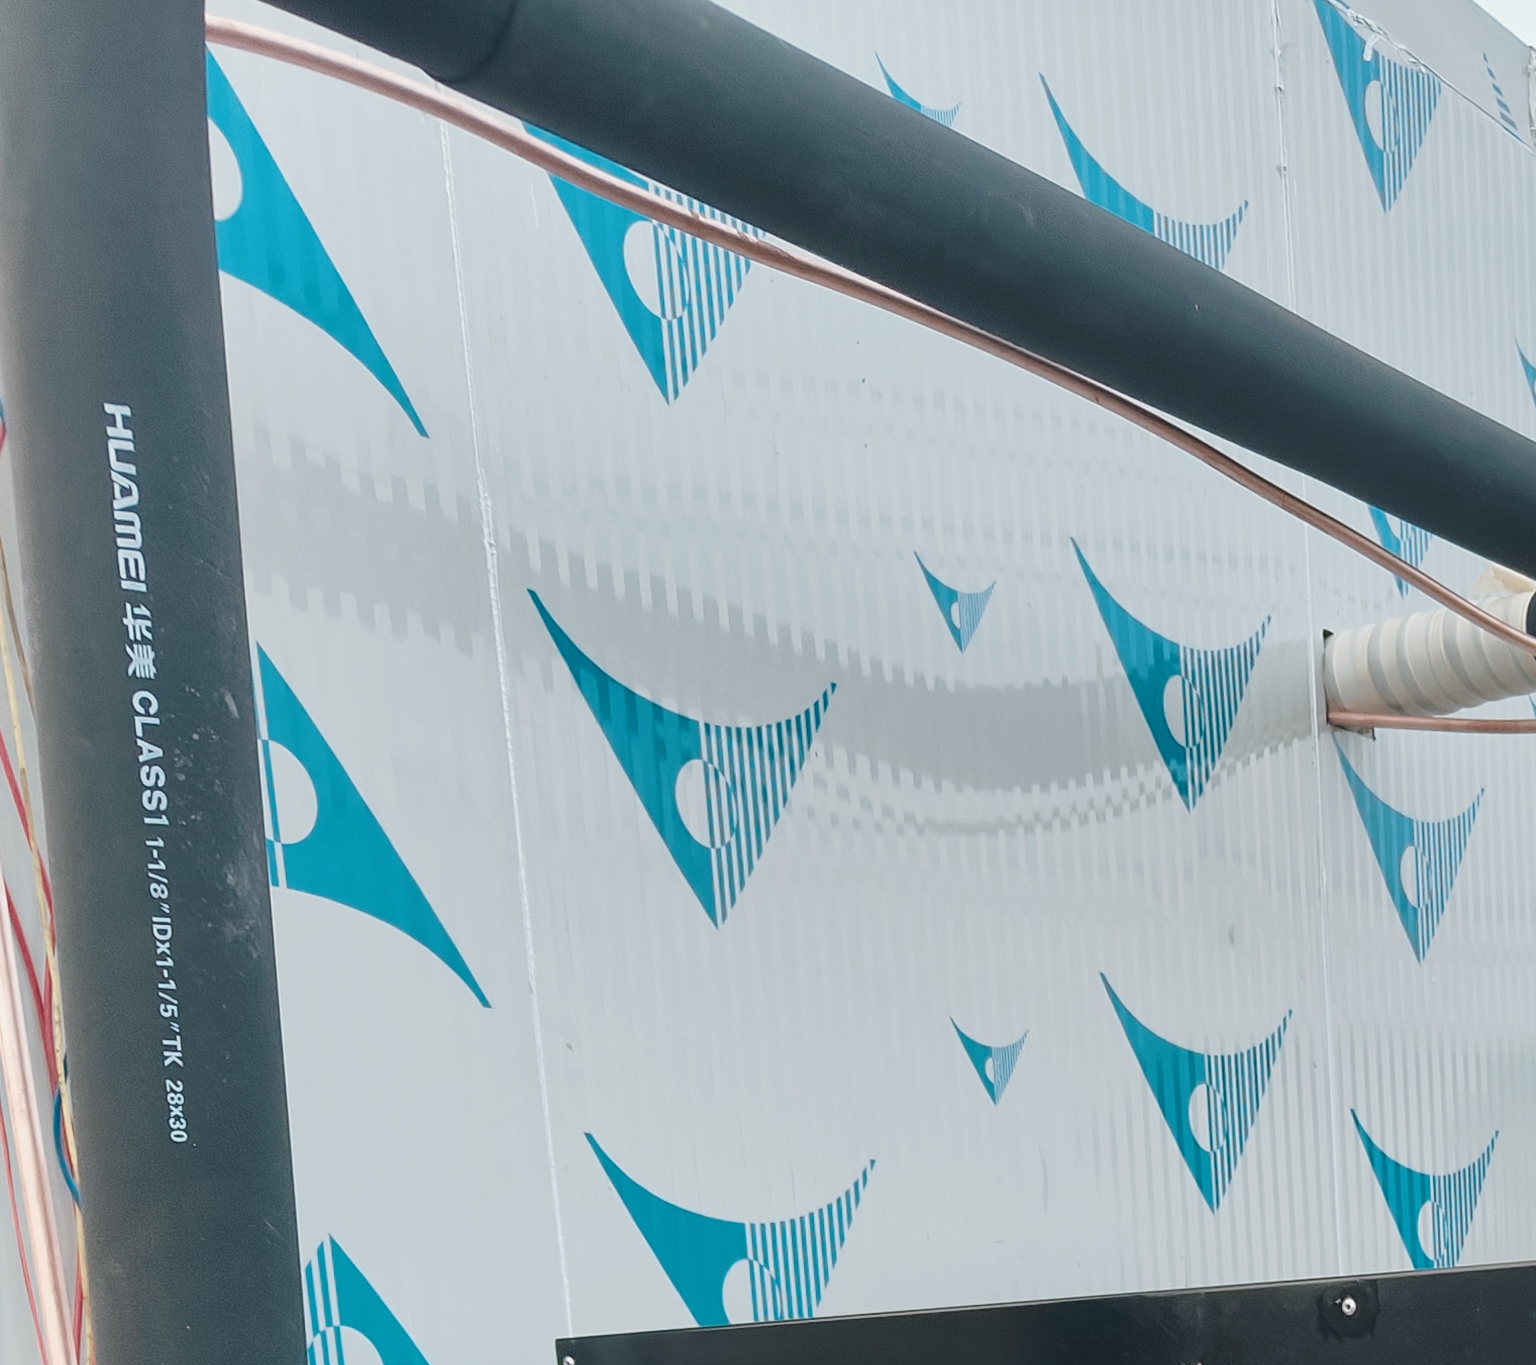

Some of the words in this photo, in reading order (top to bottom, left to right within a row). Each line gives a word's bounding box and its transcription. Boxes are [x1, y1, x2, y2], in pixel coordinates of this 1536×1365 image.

[104, 402, 147, 593] HUAMEI
[122, 602, 157, 681] 华美
[131, 690, 170, 825] CLASS1
[165, 1079, 188, 1143] 28x30
